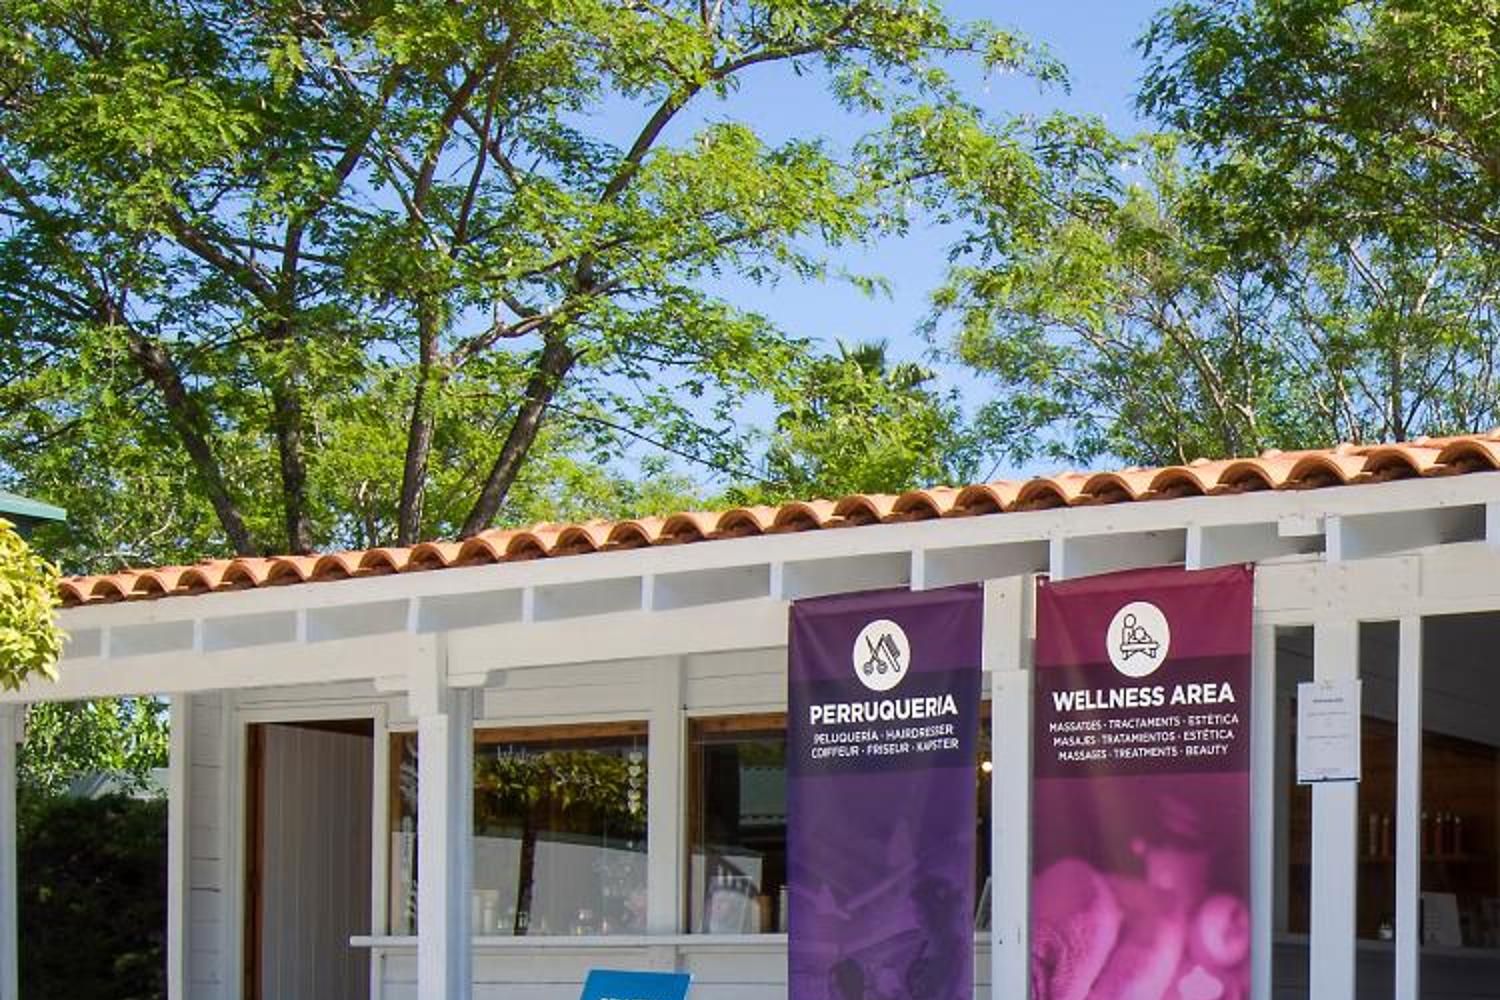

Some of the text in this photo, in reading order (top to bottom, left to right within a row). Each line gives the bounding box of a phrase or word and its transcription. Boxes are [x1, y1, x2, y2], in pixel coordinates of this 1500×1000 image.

[1052, 682, 1235, 712] WELLNESS AREA
[809, 694, 958, 725] PERRUQUERIA
[885, 723, 954, 741] HAIRDRESSER
[1108, 715, 1181, 730] TRACTAMENTS
[1053, 735, 1097, 748] MASAJES
[1101, 731, 1176, 745] TRATAMIENTOS
[811, 745, 859, 760] COIFFEUR
[866, 741, 909, 756] FRISEUR
[1058, 743, 1228, 762] MASSAGES TREATMENTS BEAUTY
